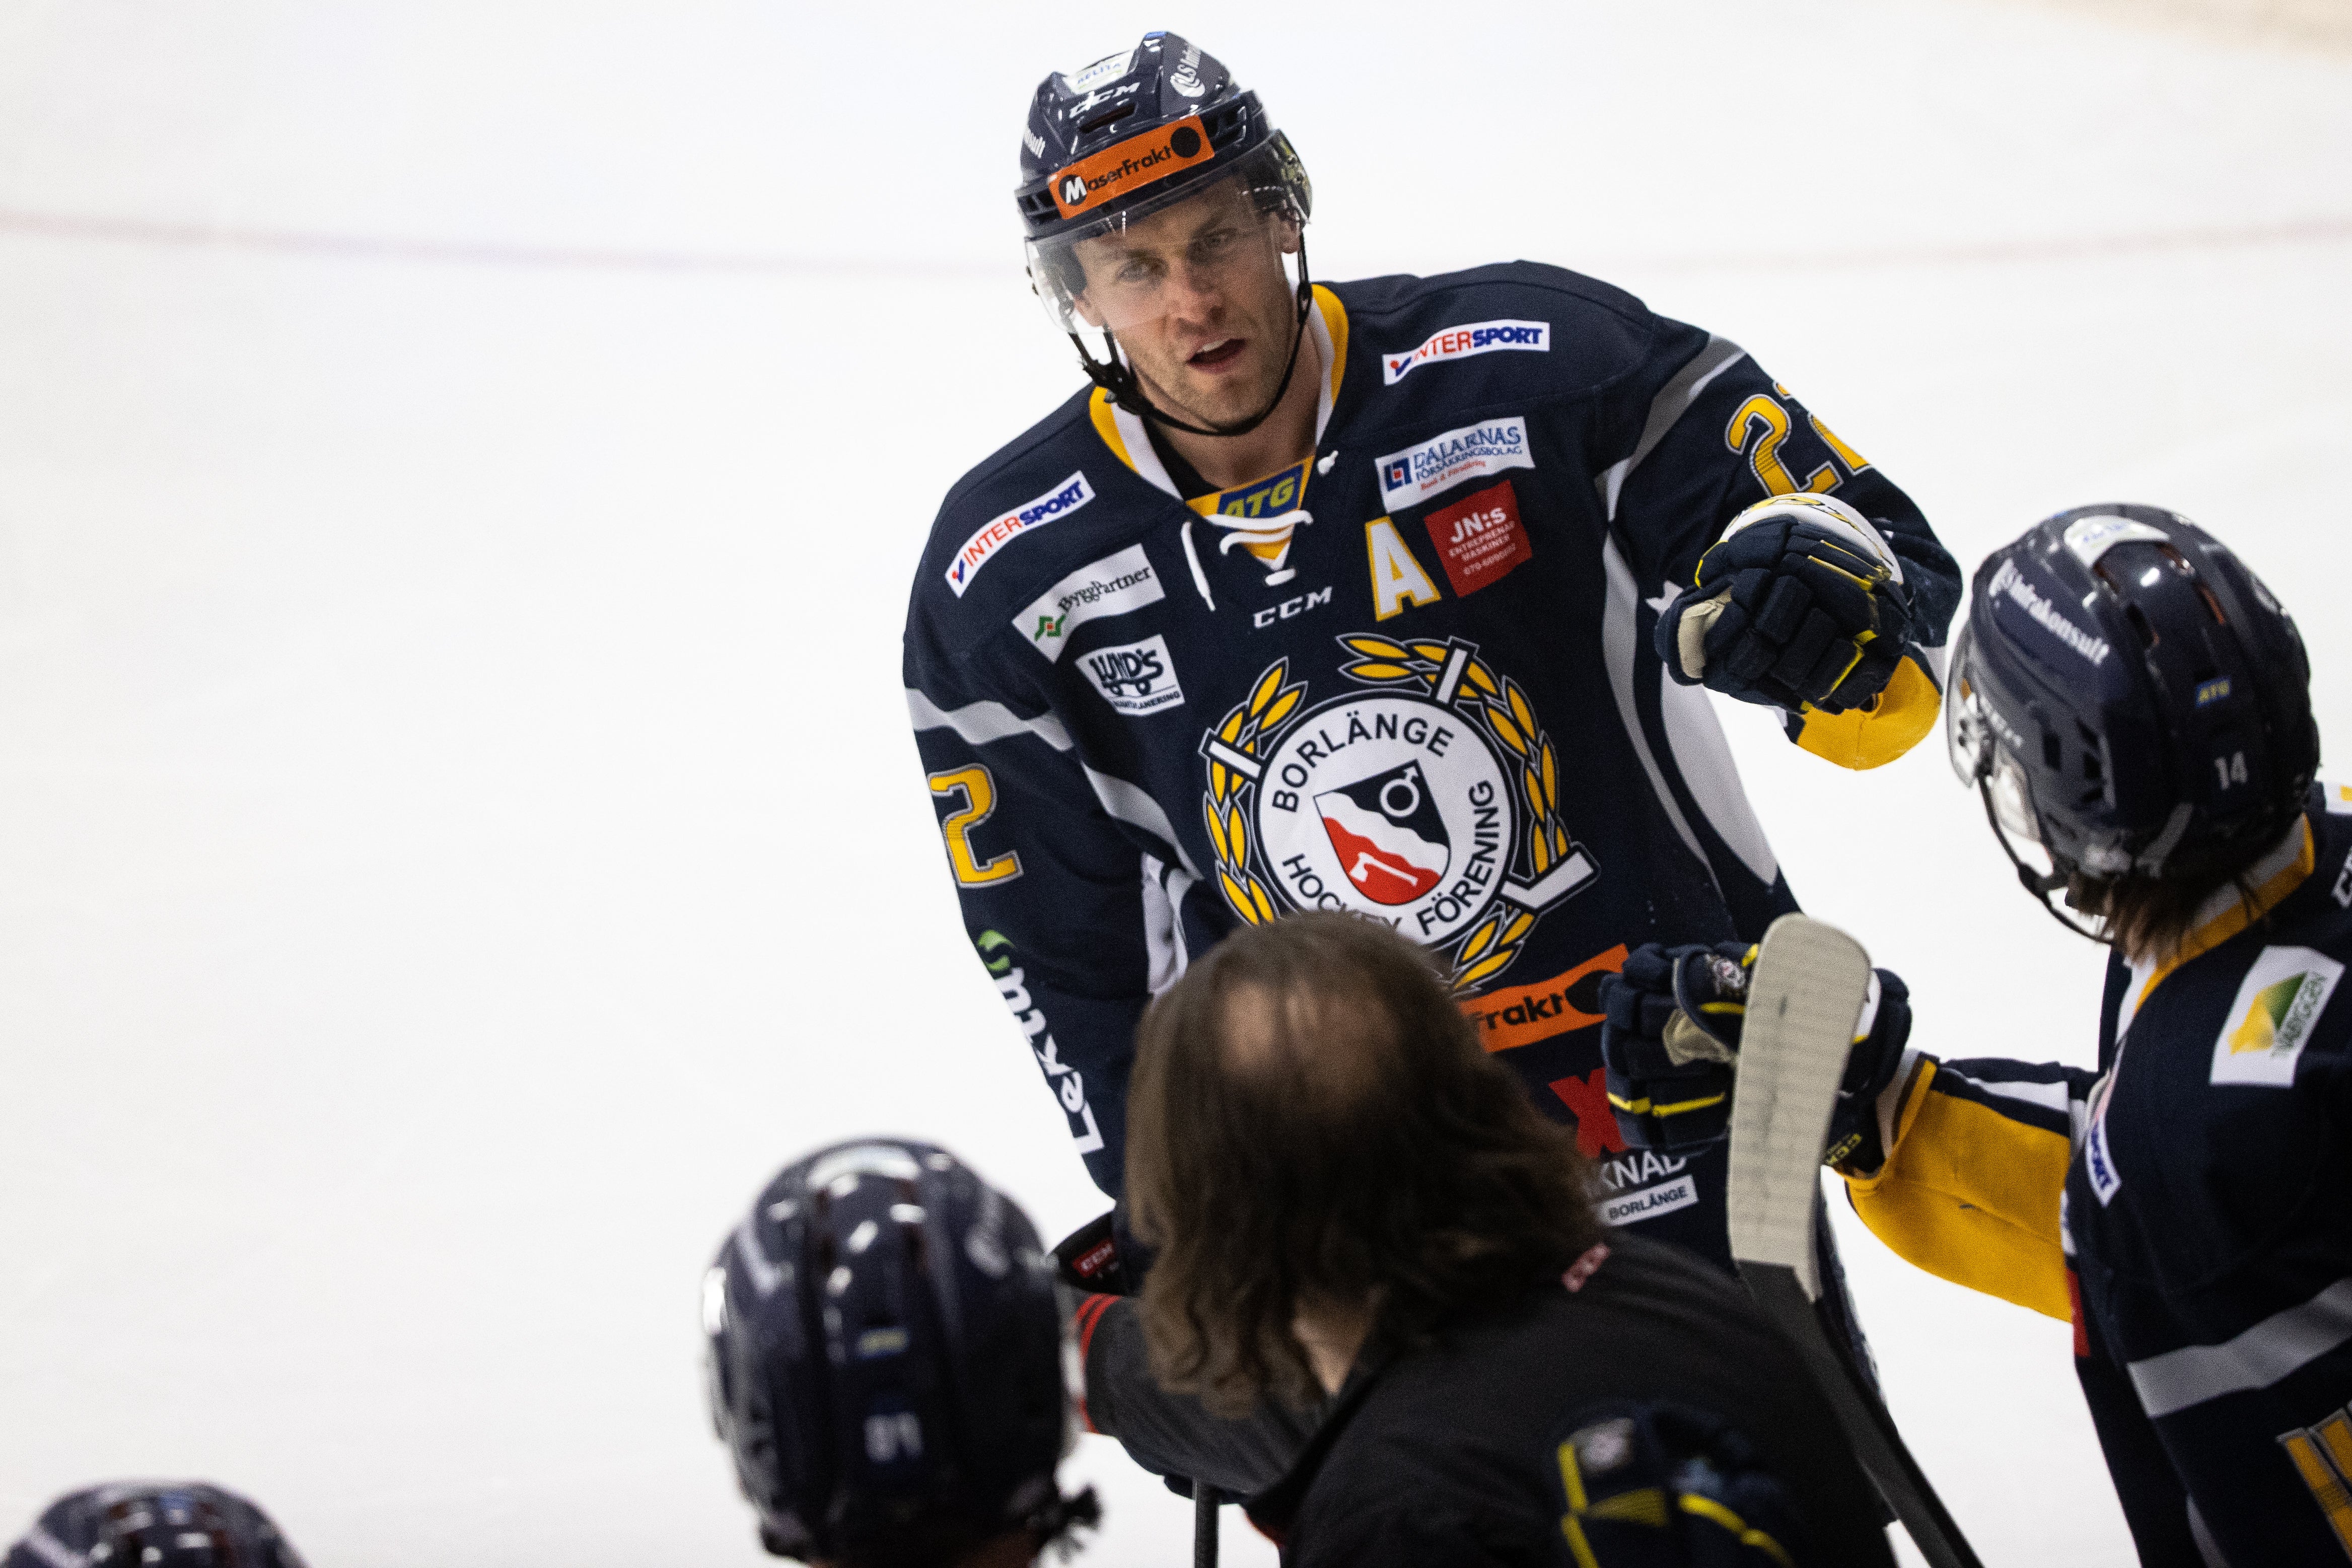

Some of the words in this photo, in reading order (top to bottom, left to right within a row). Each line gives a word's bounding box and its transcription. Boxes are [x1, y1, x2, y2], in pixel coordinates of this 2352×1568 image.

[1065, 145, 1172, 204] MaserFrakt
[1413, 426, 1521, 469] DALARNAS
[1224, 476, 1295, 518] ATG
[964, 480, 1085, 567] INTERSPORT
[1450, 507, 1507, 544] JN:s
[1364, 516, 1442, 622] A
[1253, 586, 1333, 629] CCM
[1272, 710, 1454, 813] BORLÄNGE
[2215, 751, 2248, 790] 14
[1416, 779, 1500, 937] FÖRENING
